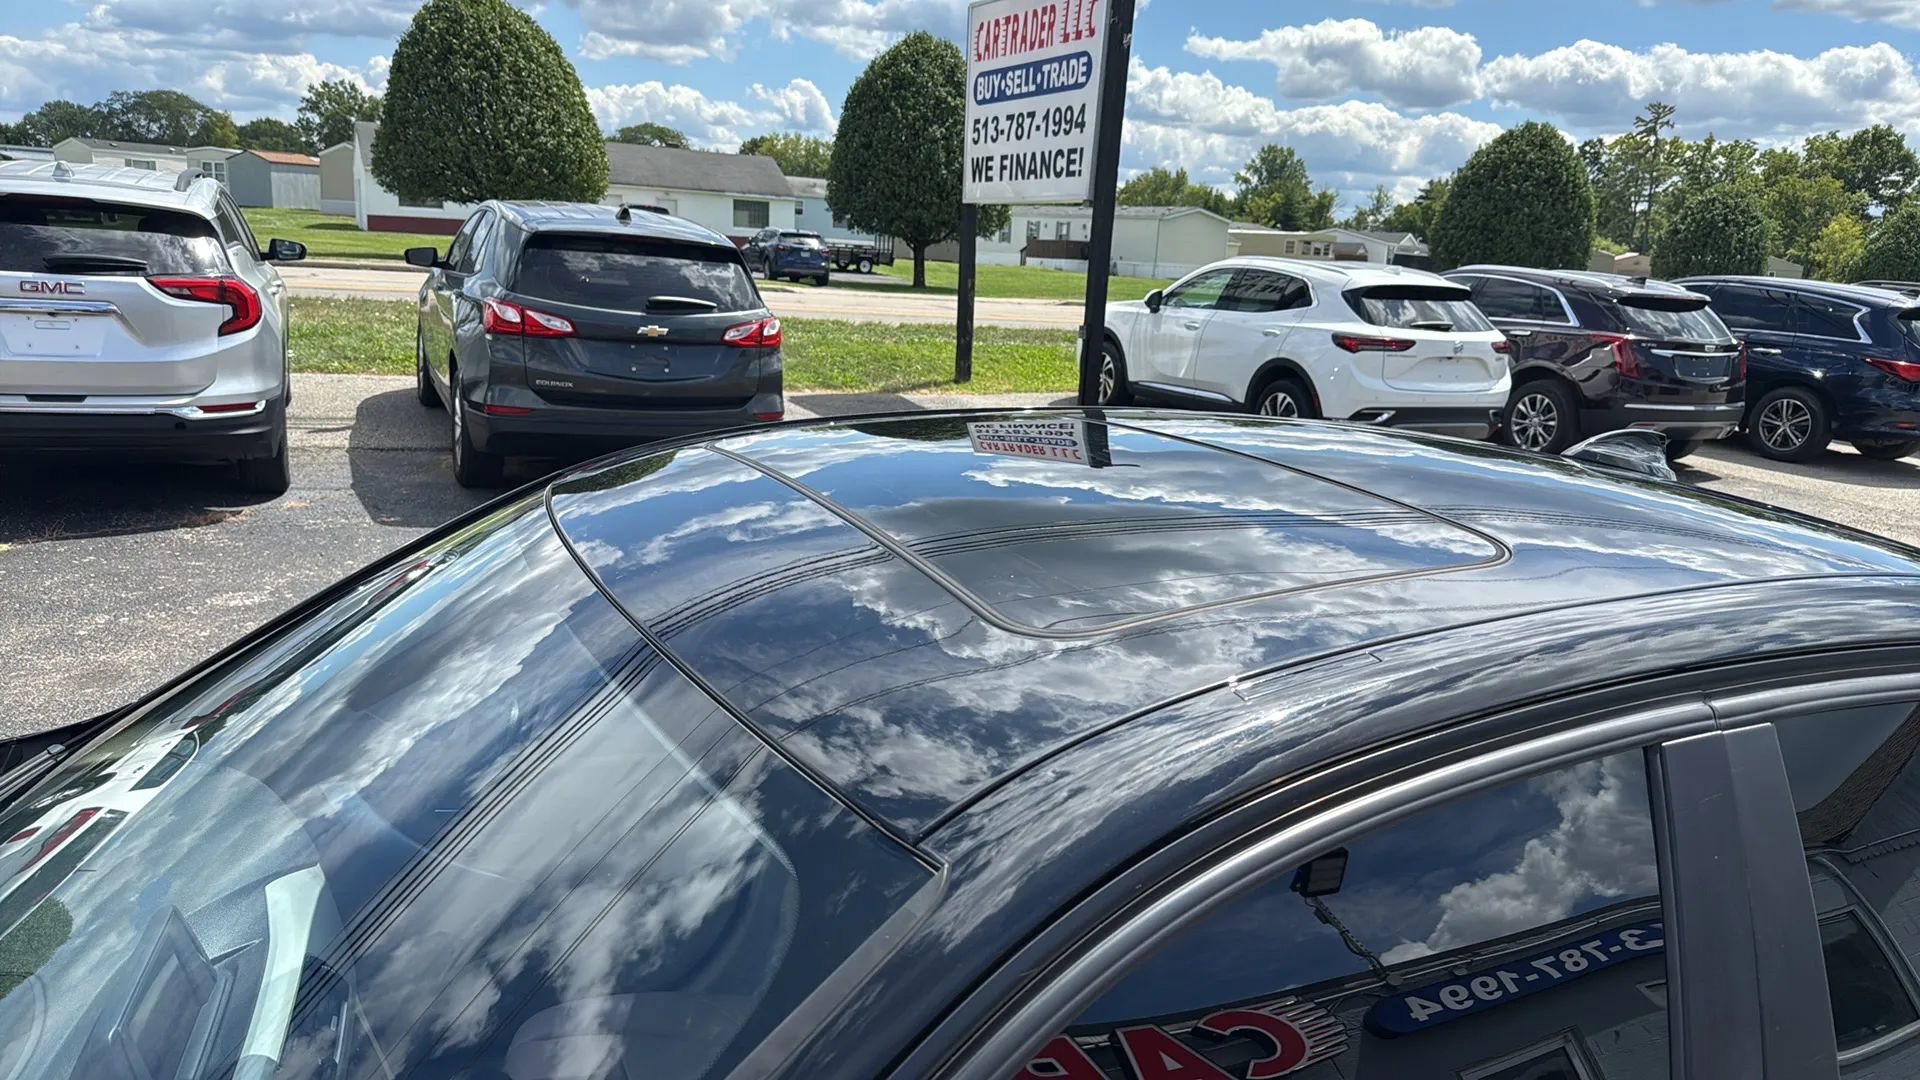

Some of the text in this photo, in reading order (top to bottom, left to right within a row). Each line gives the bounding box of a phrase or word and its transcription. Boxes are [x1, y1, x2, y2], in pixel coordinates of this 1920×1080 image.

[1060, 0, 1097, 44] LLC
[972, 103, 1087, 145] 513-787-1994
[971, 147, 1084, 183] WE FINANCE!
[19, 280, 85, 294] GMC
[535, 379, 574, 388] EQUINOX
